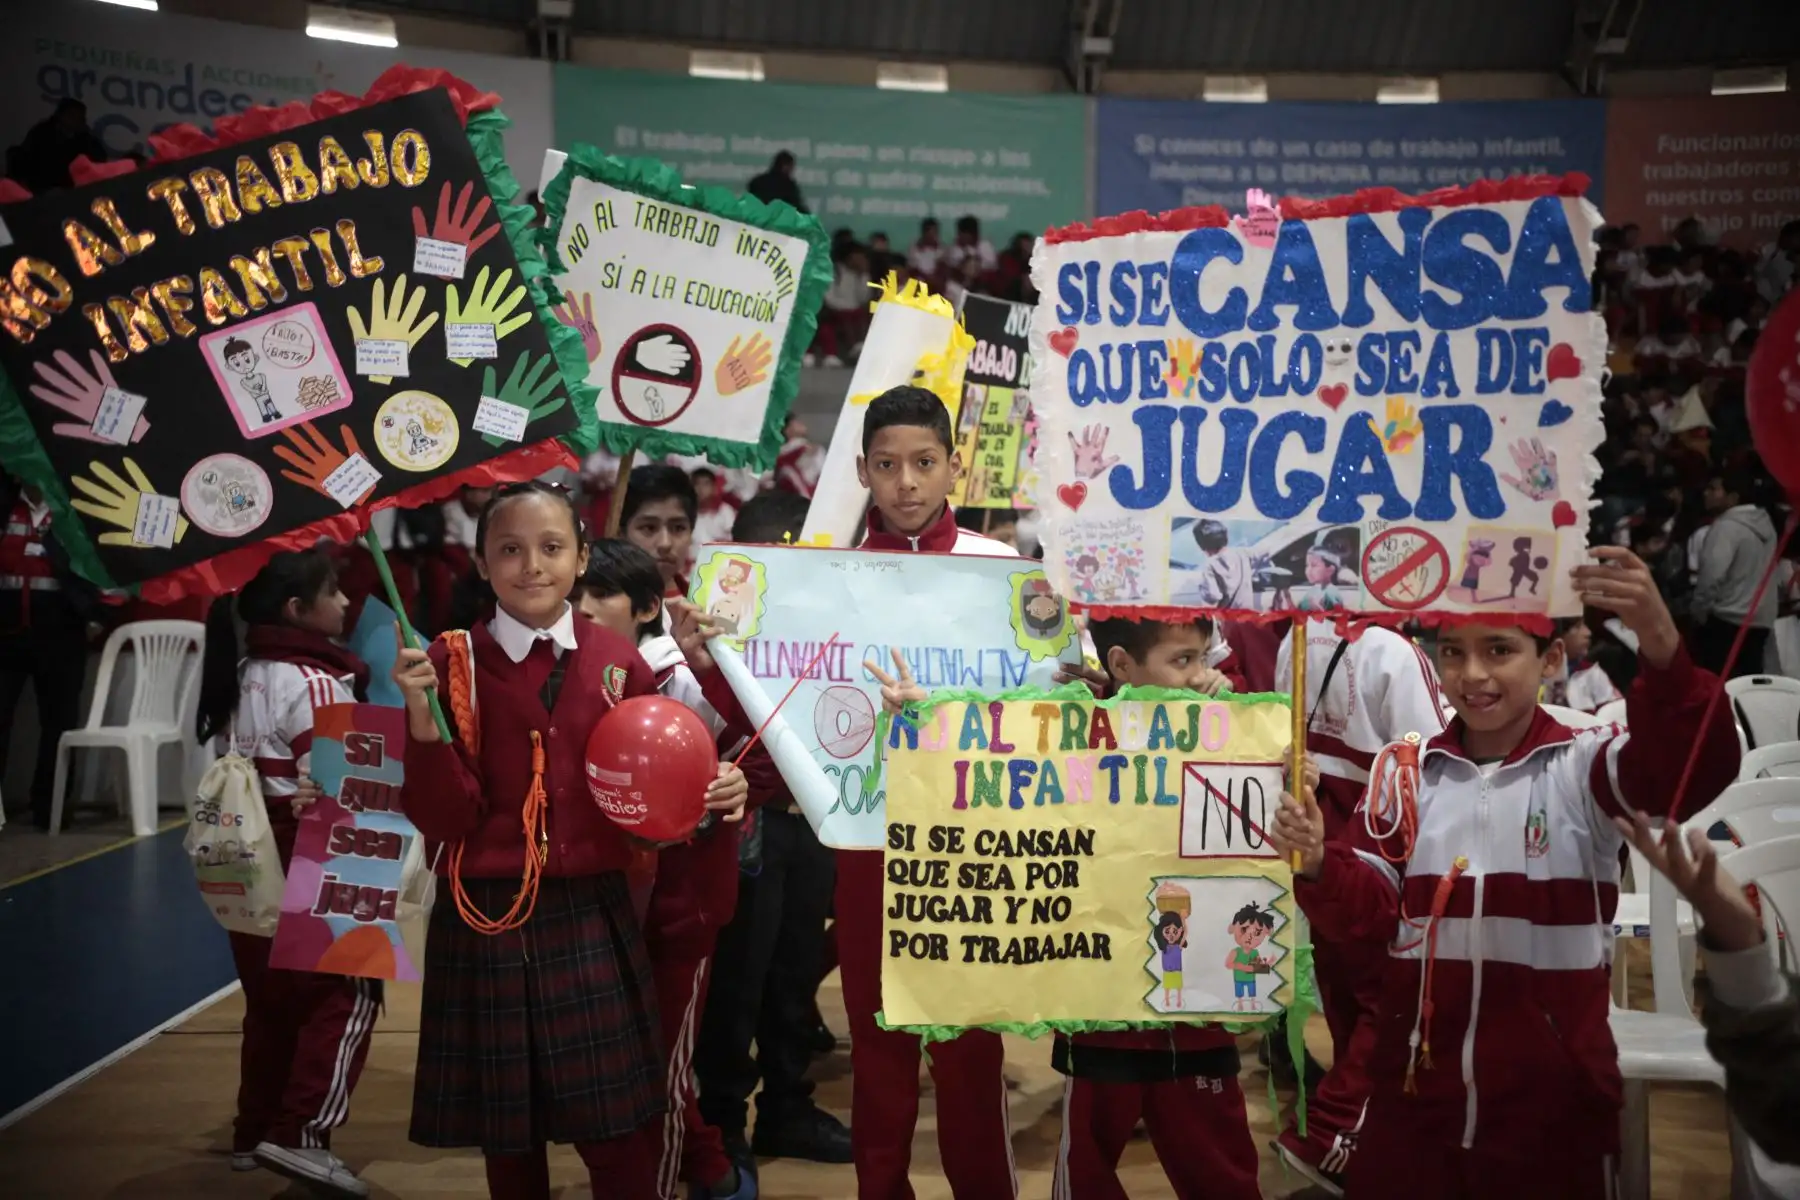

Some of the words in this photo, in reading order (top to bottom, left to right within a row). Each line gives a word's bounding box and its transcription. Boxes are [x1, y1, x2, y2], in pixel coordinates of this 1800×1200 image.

[202, 63, 318, 94] ACCIONES
[1400, 137, 1479, 161] trabajo
[1641, 158, 1790, 183] trabajadores
[61, 196, 156, 278] AL
[147, 128, 431, 236] TRABAJO
[1644, 186, 1745, 207] nuestros
[566, 222, 590, 264] NO
[593, 199, 619, 234] AL
[633, 200, 721, 248] TRABAJO
[630, 268, 648, 296] A
[651, 274, 677, 300] LA
[1055, 260, 1102, 326] SI
[1108, 260, 1171, 327] SE
[1168, 195, 1594, 339] CANSA
[82, 218, 385, 364] INFANTIL
[726, 357, 751, 392] ALTO
[1067, 339, 1169, 408] QUE
[1197, 332, 1324, 404] SOLO
[1354, 329, 1462, 399] SEA
[1475, 326, 1550, 395] DE
[1108, 404, 1507, 524] JUGAR
[1382, 536, 1398, 552] NO
[986, 647, 1030, 688] AL
[888, 706, 948, 751] NO
[958, 701, 1016, 754] AL
[1031, 702, 1231, 754] TRABAJO
[951, 755, 1180, 811] INFANTIL
[1201, 776, 1268, 851] NO
[887, 822, 917, 853] SI
[928, 824, 966, 854] SE
[974, 828, 1096, 858] CANSAN
[887, 859, 950, 891] QUE
[957, 862, 1016, 891] SEA
[1025, 861, 1080, 890] POR
[887, 893, 994, 924] JUGAR
[1005, 896, 1028, 925] Y
[1030, 895, 1073, 925] NO
[888, 929, 949, 962] POR
[960, 932, 1113, 965] TRABAJAR
